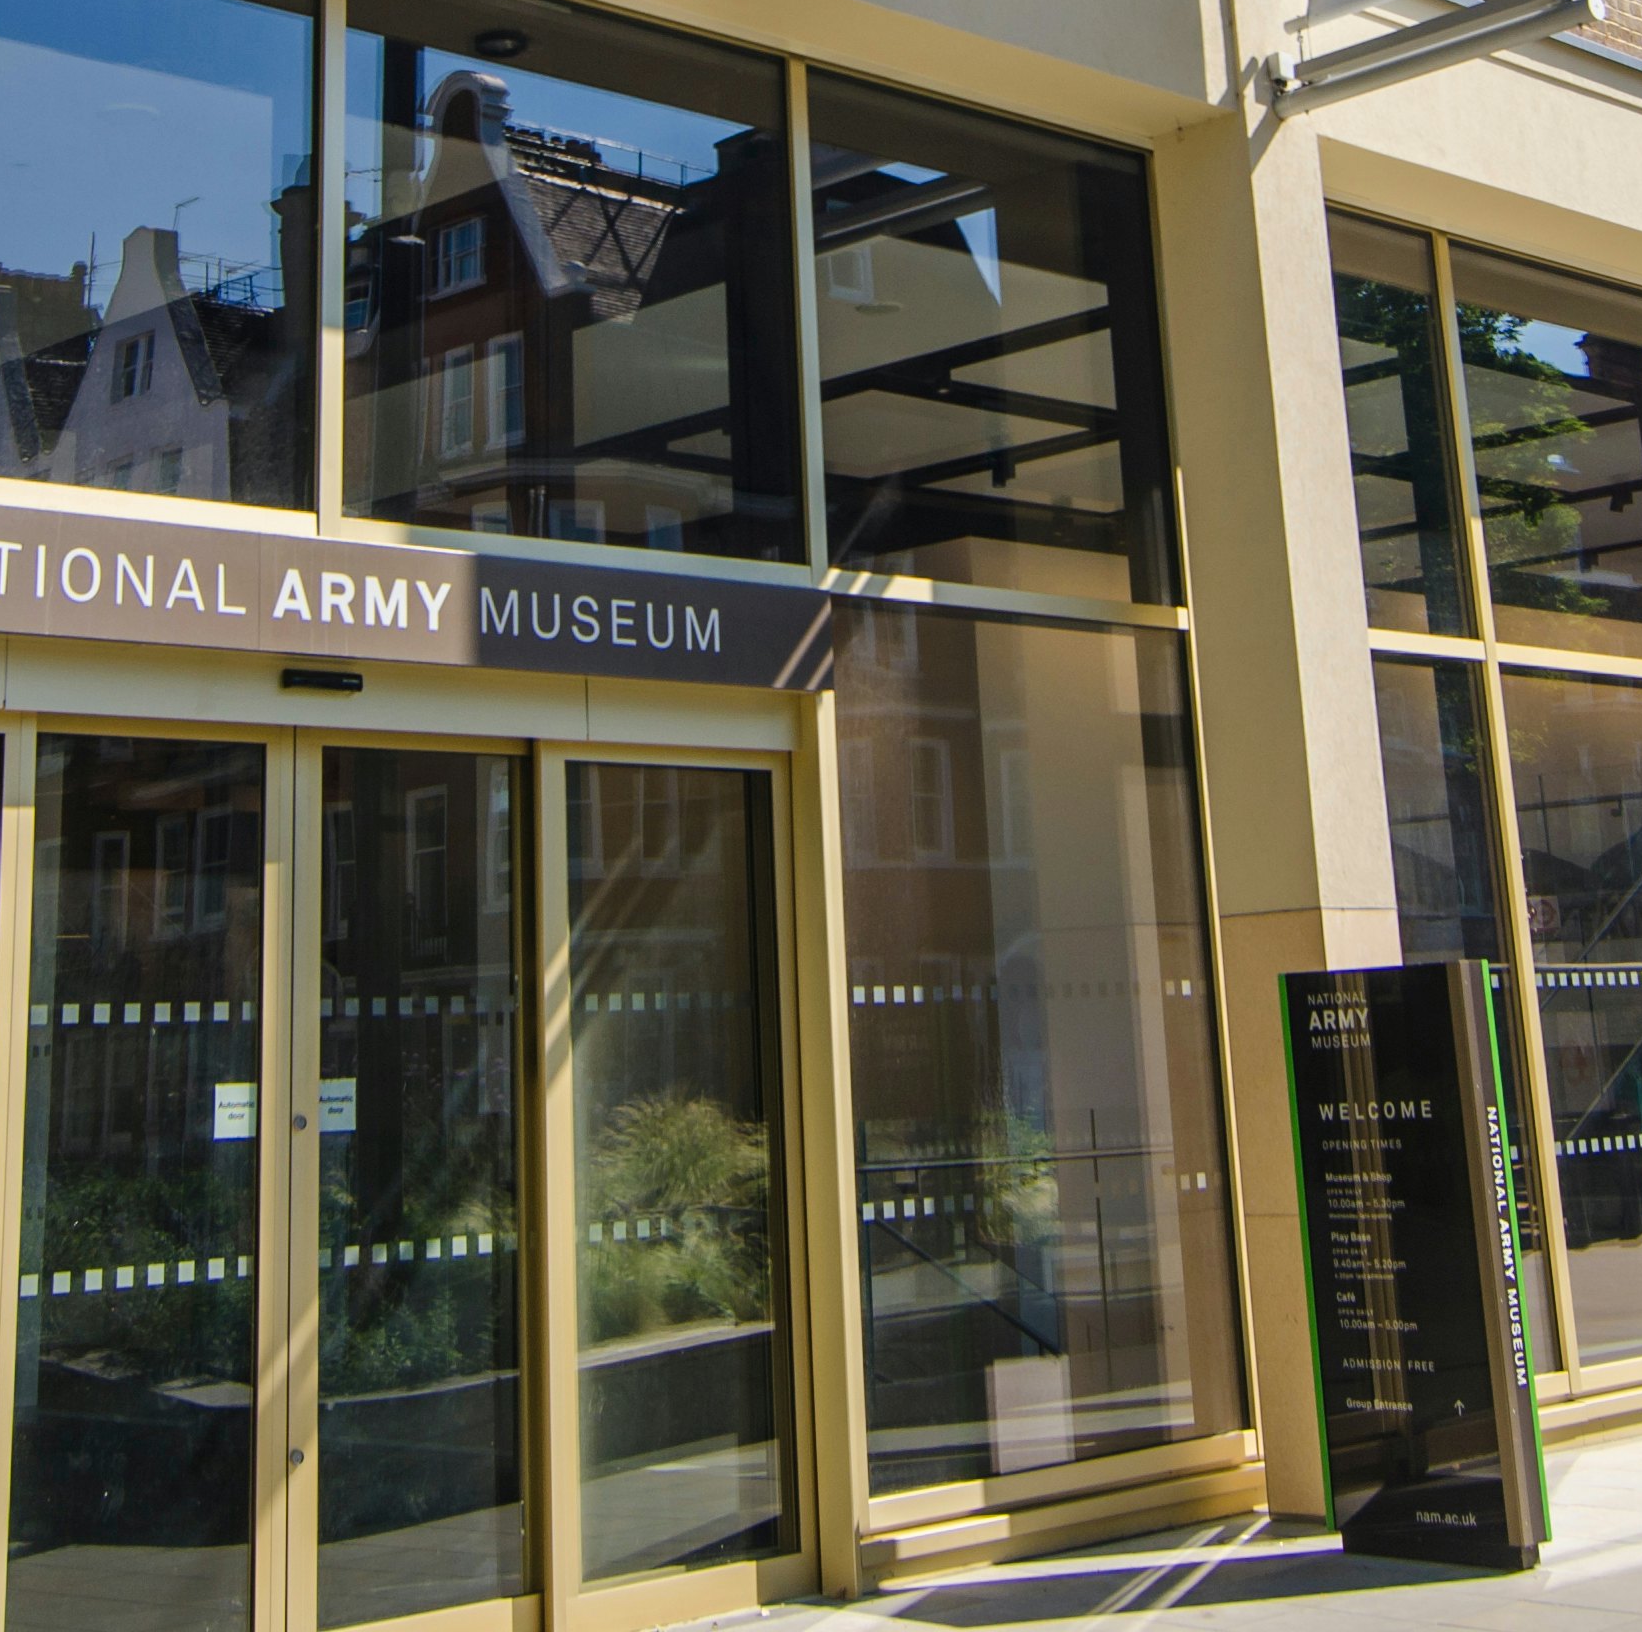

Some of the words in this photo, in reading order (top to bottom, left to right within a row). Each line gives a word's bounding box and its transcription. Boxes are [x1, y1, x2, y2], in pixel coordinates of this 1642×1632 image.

[271, 567, 452, 632] ARMY
[480, 586, 721, 653] MUSEUM
[1307, 990, 1368, 1006] NATIONAL
[1309, 1008, 1369, 1031] ARMY
[1311, 1033, 1371, 1049] MUSEUM
[1318, 1100, 1433, 1121] WELCOME
[1322, 1139, 1367, 1151] OPENING
[1370, 1138, 1402, 1150] TIMES
[1486, 1106, 1508, 1214] NATIONAL
[1325, 1172, 1361, 1183] Museum
[1499, 1217, 1516, 1281] ARMY
[1507, 1287, 1527, 1387] MUSEUM
[1342, 1357, 1401, 1370] ADMISSION
[1407, 1358, 1435, 1373] FREE
[1346, 1397, 1372, 1412] Group
[1373, 1398, 1413, 1412] Entrance
[1415, 1509, 1477, 1527] nam.ac.uk
